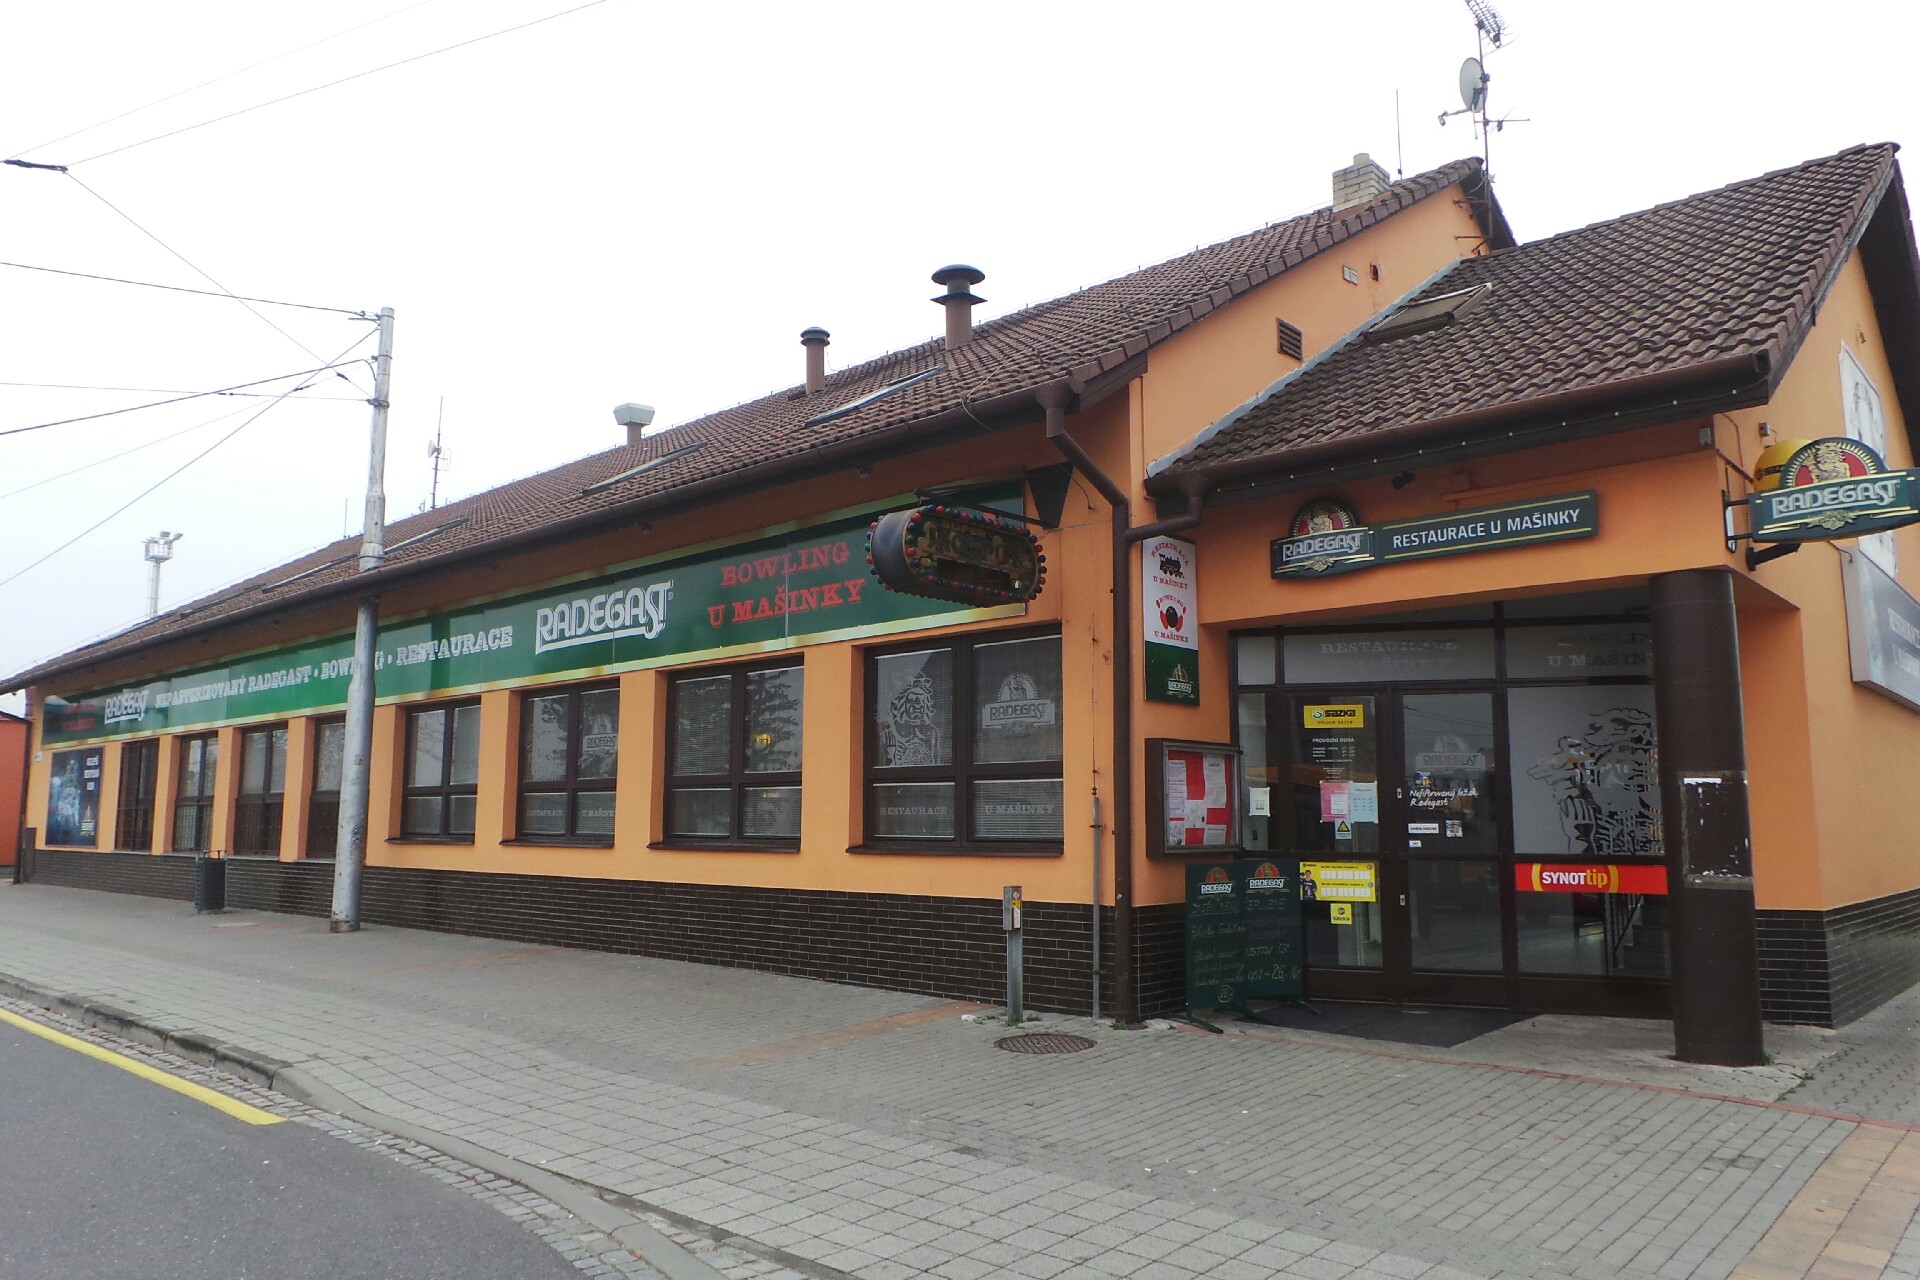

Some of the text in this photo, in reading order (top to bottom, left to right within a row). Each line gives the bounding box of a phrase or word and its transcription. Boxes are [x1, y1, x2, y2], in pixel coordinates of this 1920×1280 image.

[1771, 479, 1901, 519] RADEGAST
[1281, 531, 1364, 562] RADEGAST
[1393, 508, 1580, 549] RESTAURACE U MAŠINKY
[720, 540, 850, 588] BOWLING
[536, 579, 673, 656] RADEGAST
[707, 578, 866, 627] U MAŠINKY
[247, 665, 312, 693] RADEGAST
[396, 626, 513, 667] RESTAURACE
[104, 690, 150, 725] RADEGAST
[989, 702, 1047, 720] RADEGAST
[1410, 799, 1448, 810] Radegast
[1249, 878, 1285, 889] RADEGAST
